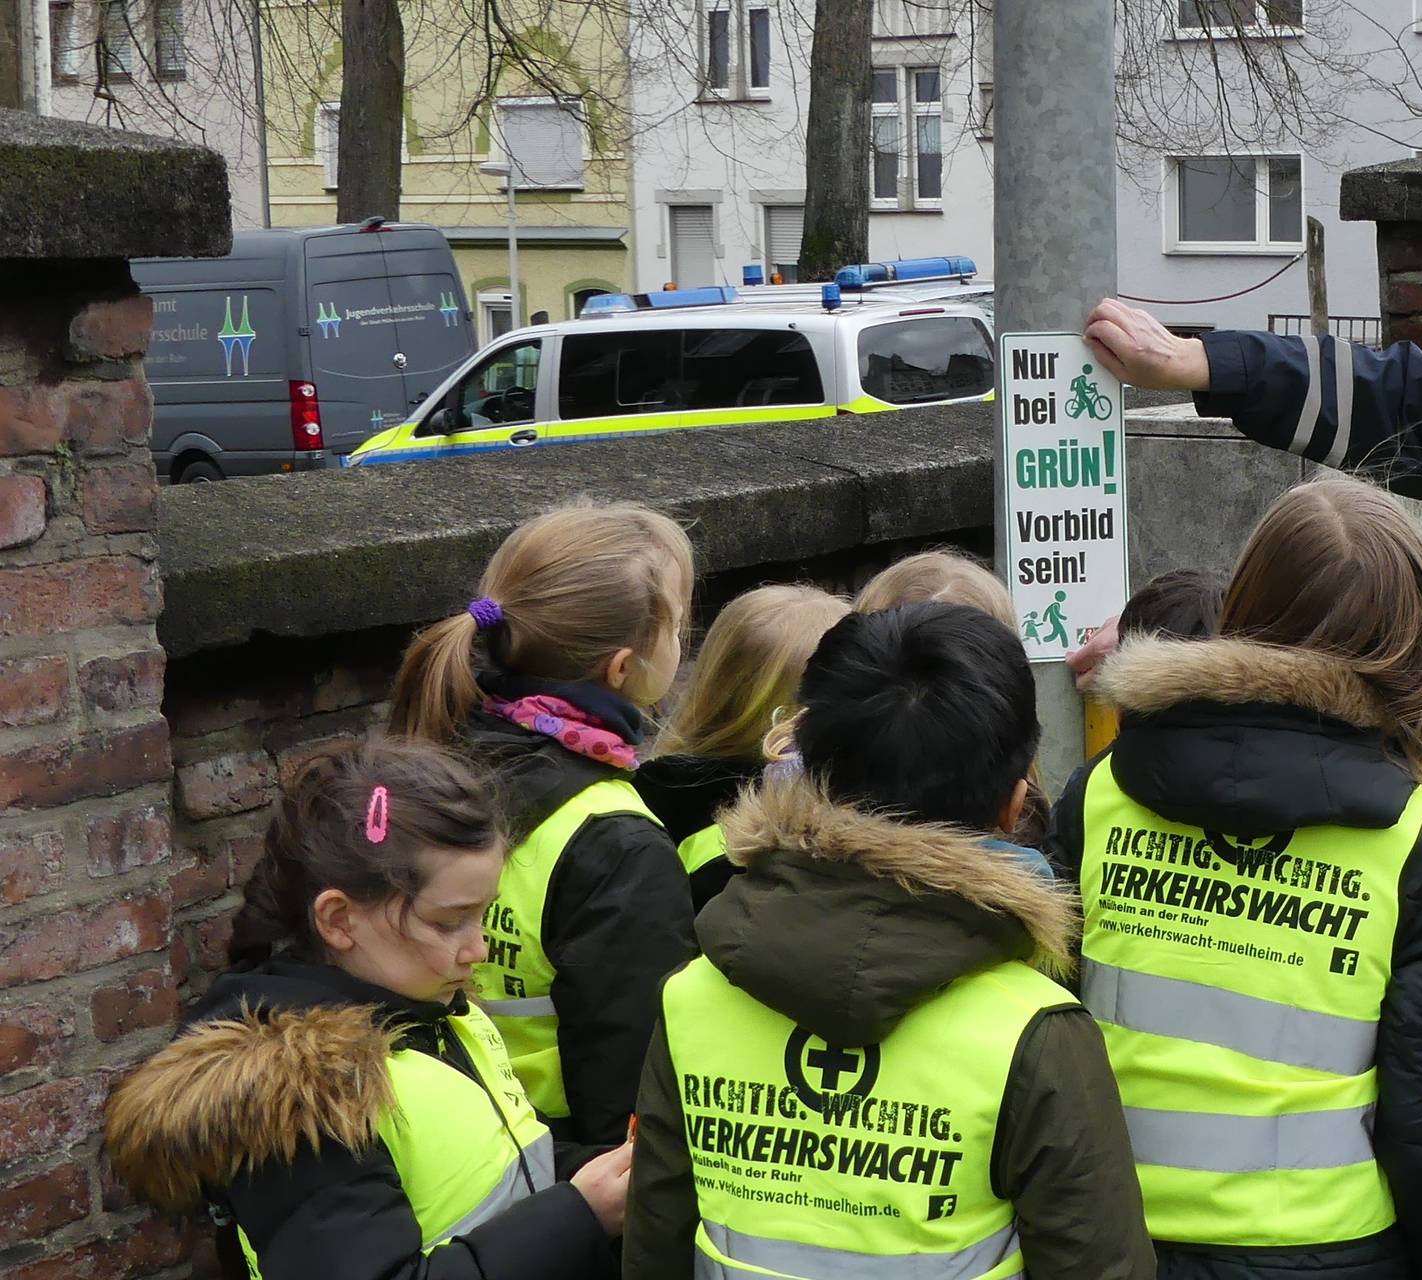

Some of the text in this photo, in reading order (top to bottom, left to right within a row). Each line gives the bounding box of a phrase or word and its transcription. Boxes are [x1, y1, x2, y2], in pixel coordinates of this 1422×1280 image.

[1012, 349, 1059, 380] Nur
[1013, 392, 1057, 426] bei
[1015, 430, 1117, 495] GRÜN!
[1016, 507, 1115, 543] Vorbild
[1018, 551, 1087, 585] sein!
[1105, 826, 1371, 901] RICHTIG. WICHTIG.
[1100, 861, 1369, 941] VERKEHRSWACHT
[1139, 907, 1155, 918] an
[1158, 909, 1179, 921] der
[1181, 912, 1209, 928] Ruhr
[684, 1073, 962, 1143] RICHTIG. WICHTIG.
[685, 1113, 963, 1187] VERKEHRSWACHT
[731, 1165, 742, 1176] an
[745, 1167, 767, 1179] der
[771, 1165, 803, 1183] Ruhr
